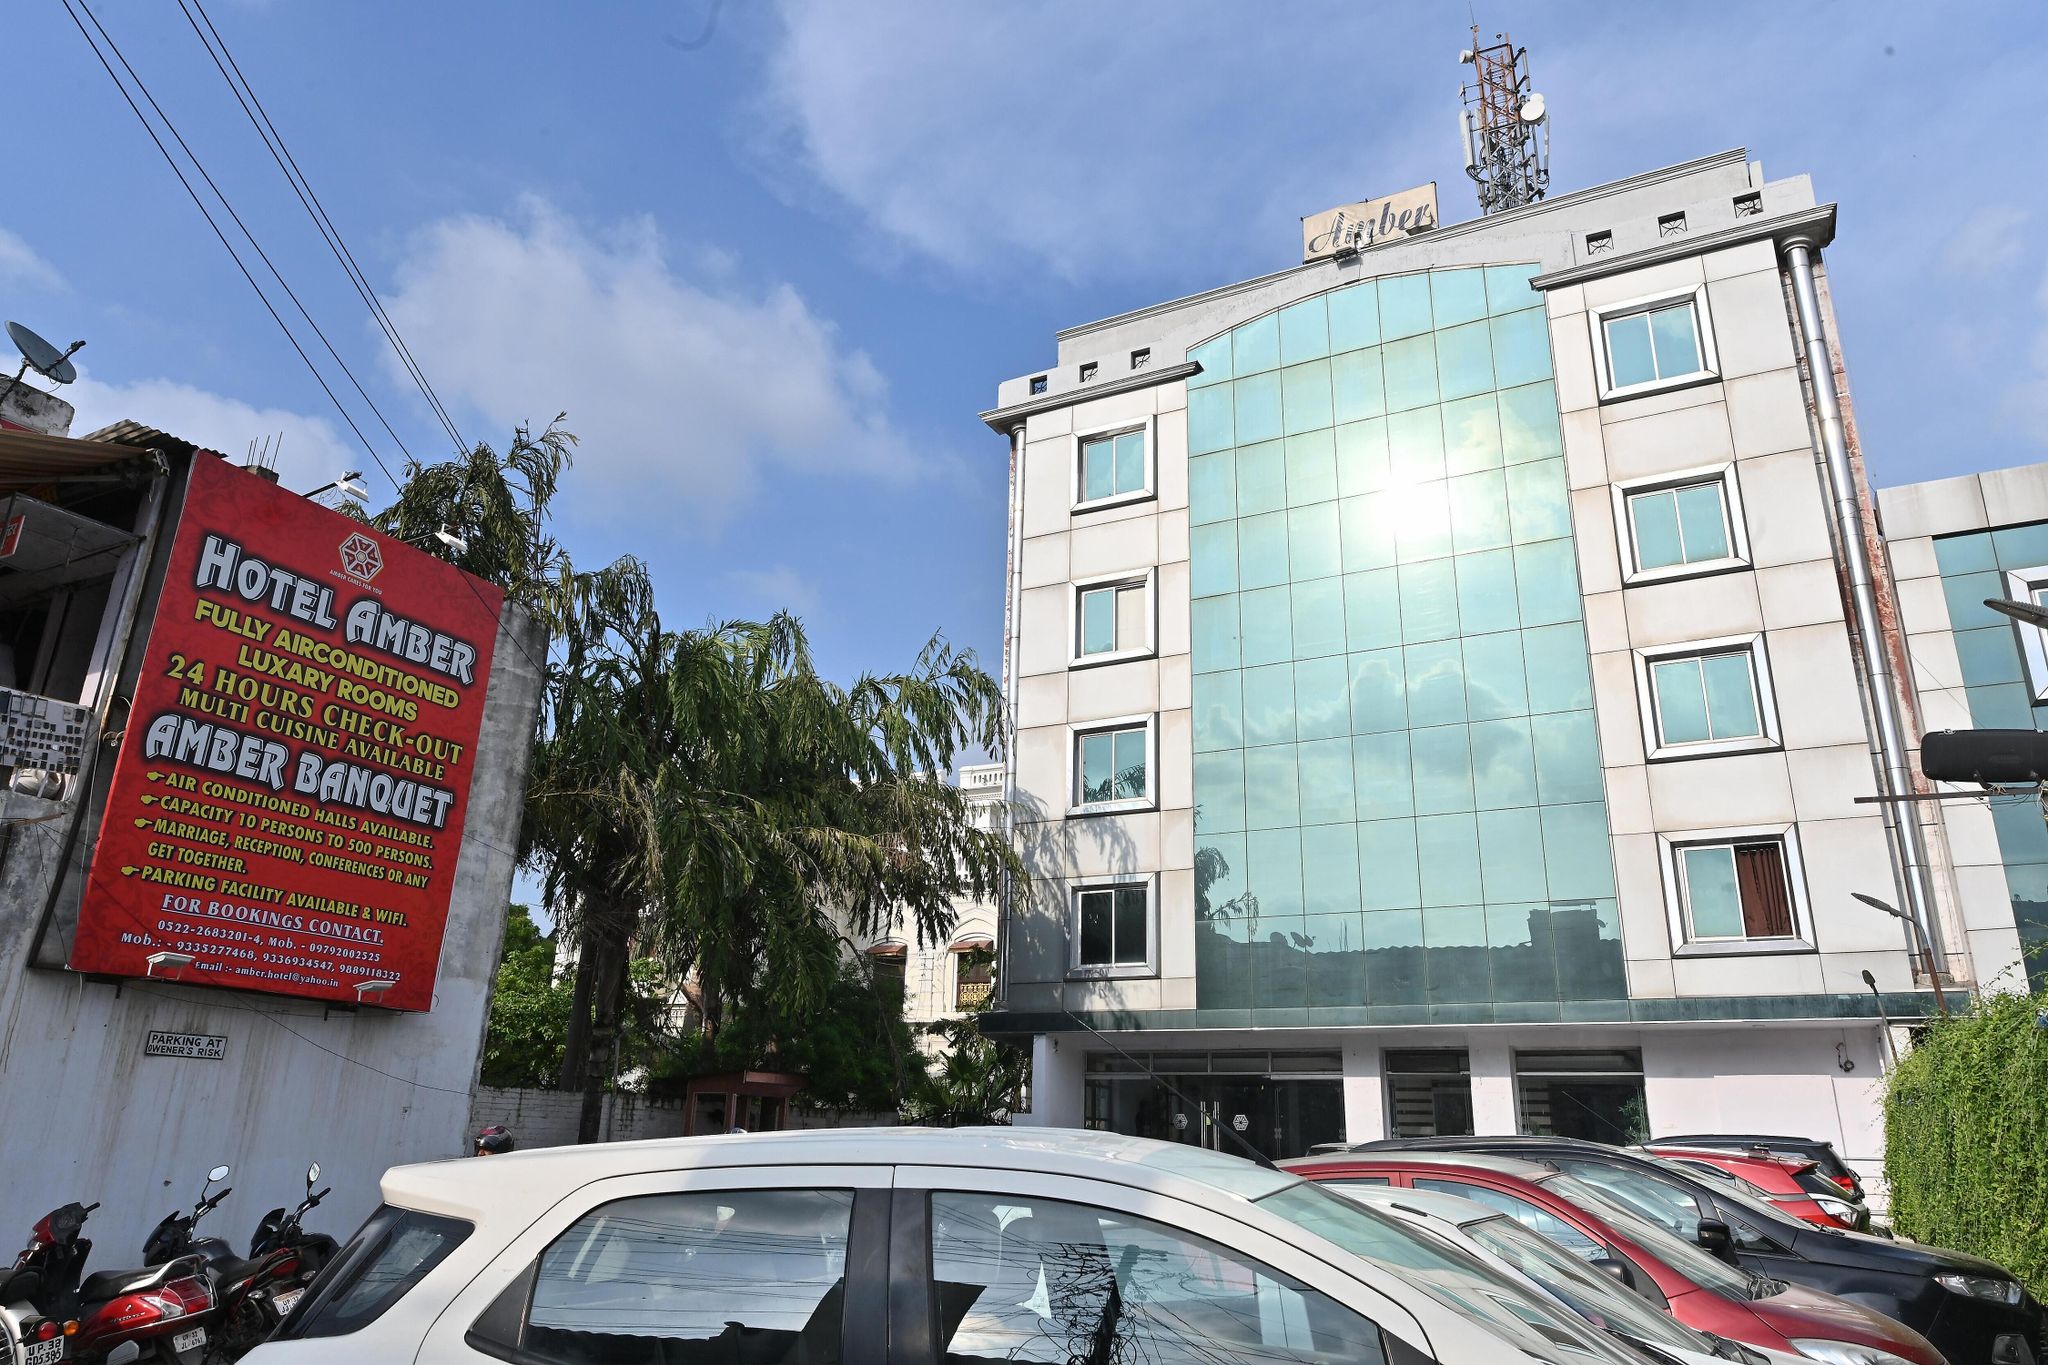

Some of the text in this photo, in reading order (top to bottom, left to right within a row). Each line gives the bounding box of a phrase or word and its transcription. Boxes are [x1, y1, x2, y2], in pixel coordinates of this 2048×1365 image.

[1308, 201, 1436, 253] Amber
[196, 535, 476, 685] HOTEL AMBER
[329, 569, 347, 580] AMBER
[362, 582, 373, 591] FOR
[372, 587, 383, 595] YOU
[194, 599, 459, 709] FULLY AIRCONDITIONED
[238, 645, 418, 721] LUXARY ROOMS
[168, 654, 463, 764] 24 HOURS CHECK-OUT
[180, 688, 445, 781] MULTI CUISINE AVAILABLE
[145, 713, 454, 828] AMBER BANQUET
[160, 795, 433, 869] CAPACITY 10 PERSONS TO 500 PERSONS.
[165, 773, 434, 849] AIR CONDITIONED HALLS AVAILABLE.
[147, 842, 247, 874] GET TOGETHER.
[153, 818, 429, 889] MARRIAGE, RECEPTION, CONFERENCES OR ANY
[141, 865, 407, 927] PARKING FACILITY AVAILABLE & WIFI.
[162, 894, 385, 944] FOR BOOKINGS CONTACT.
[176, 941, 258, 962] 9335277468,
[263, 953, 335, 973] 9336934547,
[339, 964, 401, 981] 9889118322
[195, 961, 223, 972] Email
[235, 966, 339, 988] amber.hotel@yahoo.in
[268, 937, 297, 950] Mob.
[309, 943, 381, 962] 09792002525
[147, 1044, 221, 1057] OWENER'S RISK
[151, 1034, 222, 1048] PARKING AT
